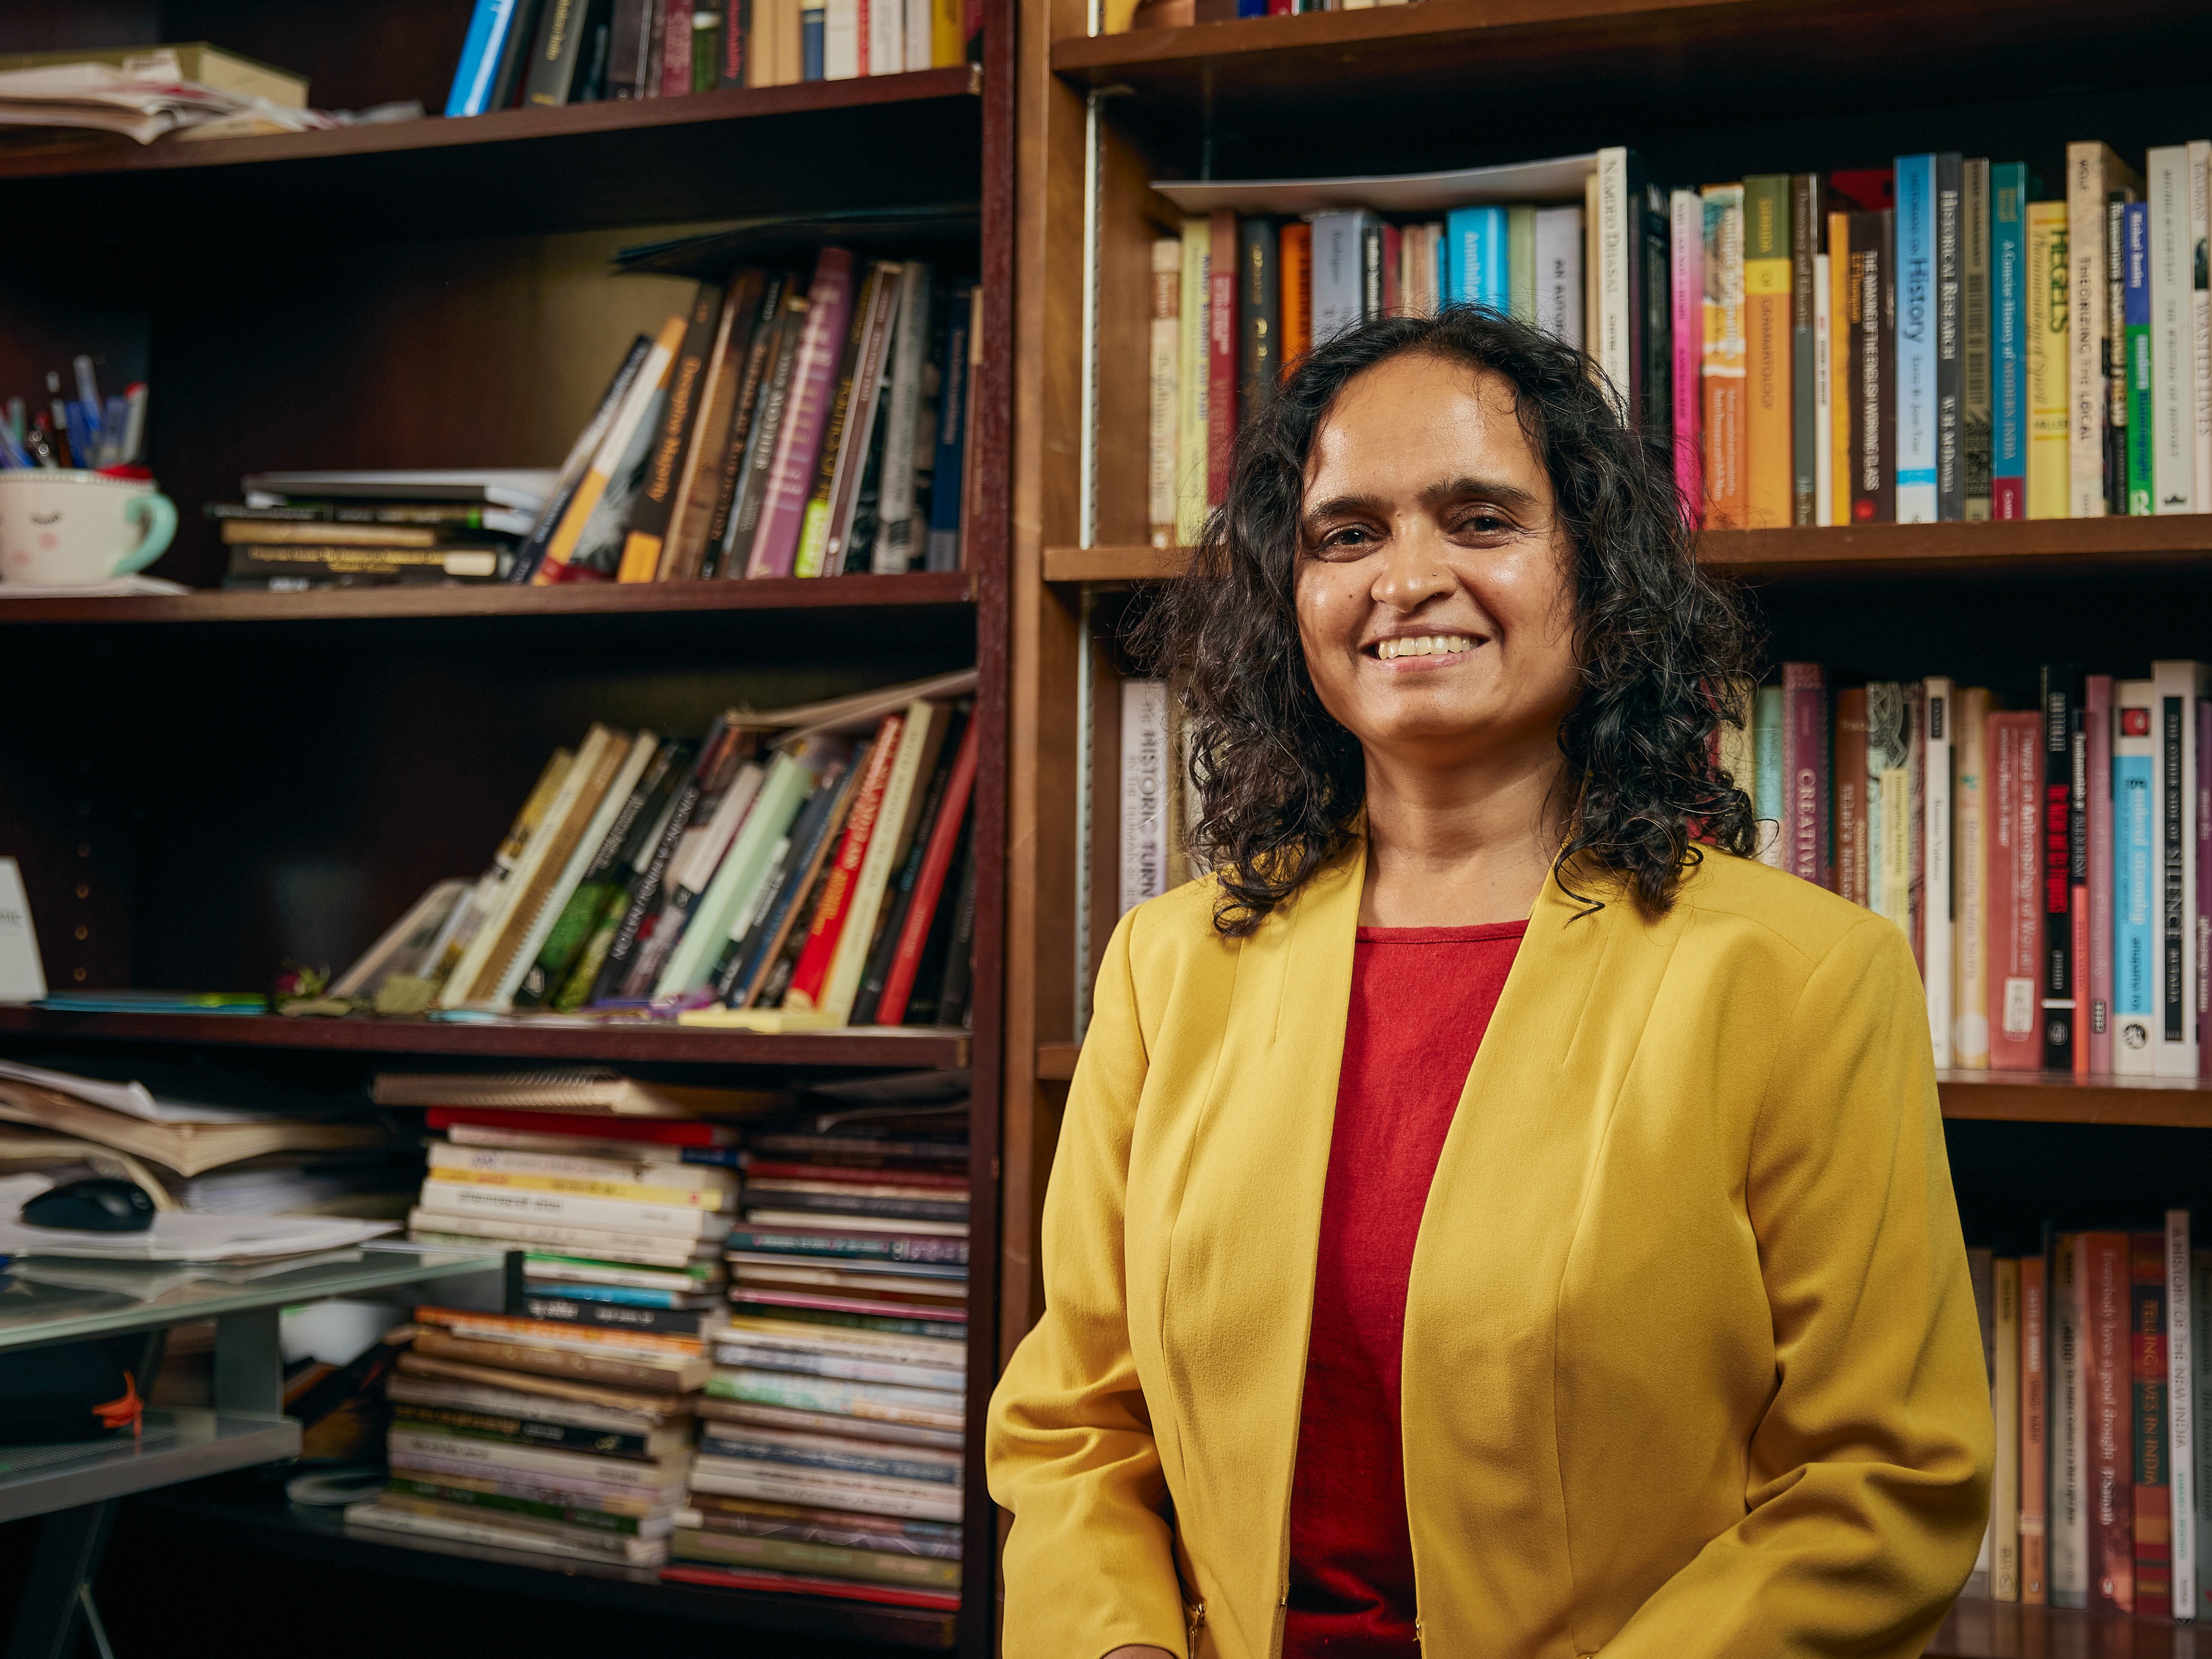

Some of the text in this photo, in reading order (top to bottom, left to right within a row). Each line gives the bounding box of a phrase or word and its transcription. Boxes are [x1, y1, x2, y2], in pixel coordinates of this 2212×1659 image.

[2078, 158, 2091, 193] WOLF
[1796, 252, 1813, 276] and
[1939, 190, 1959, 360] HISTORICAL RESEARCH
[1757, 197, 1774, 411] DERRIDA OF GRAMMATOLOGY
[1901, 257, 1930, 344] History
[1862, 250, 1879, 491] THE MAKING OF THE ENGLISH WORKING CLASS
[2078, 256, 2094, 443] THEORIZING THE LOCAL
[2195, 384, 2212, 437] LIVES
[1796, 502, 1813, 527] Dew
[1140, 730, 1158, 899] HISTORIC TURN
[1796, 768, 1817, 882] CREATIVE
[1127, 868, 1138, 911] SCIEN
[1838, 846, 1856, 903] Nation
[2128, 850, 2150, 926] citizenship
[2165, 844, 2184, 941] SILENCE
[2172, 1241, 2188, 1306] HISTORY
[2096, 1248, 2118, 1461] Everybody loves a good drought
[2172, 1311, 2188, 1330] OF
[2172, 1334, 2188, 1362] THE
[2140, 1298, 2160, 1487] TELLING LIVES IN INDIA
[2172, 1368, 2188, 1400] NEW
[2172, 1405, 2188, 1448] INDIA
